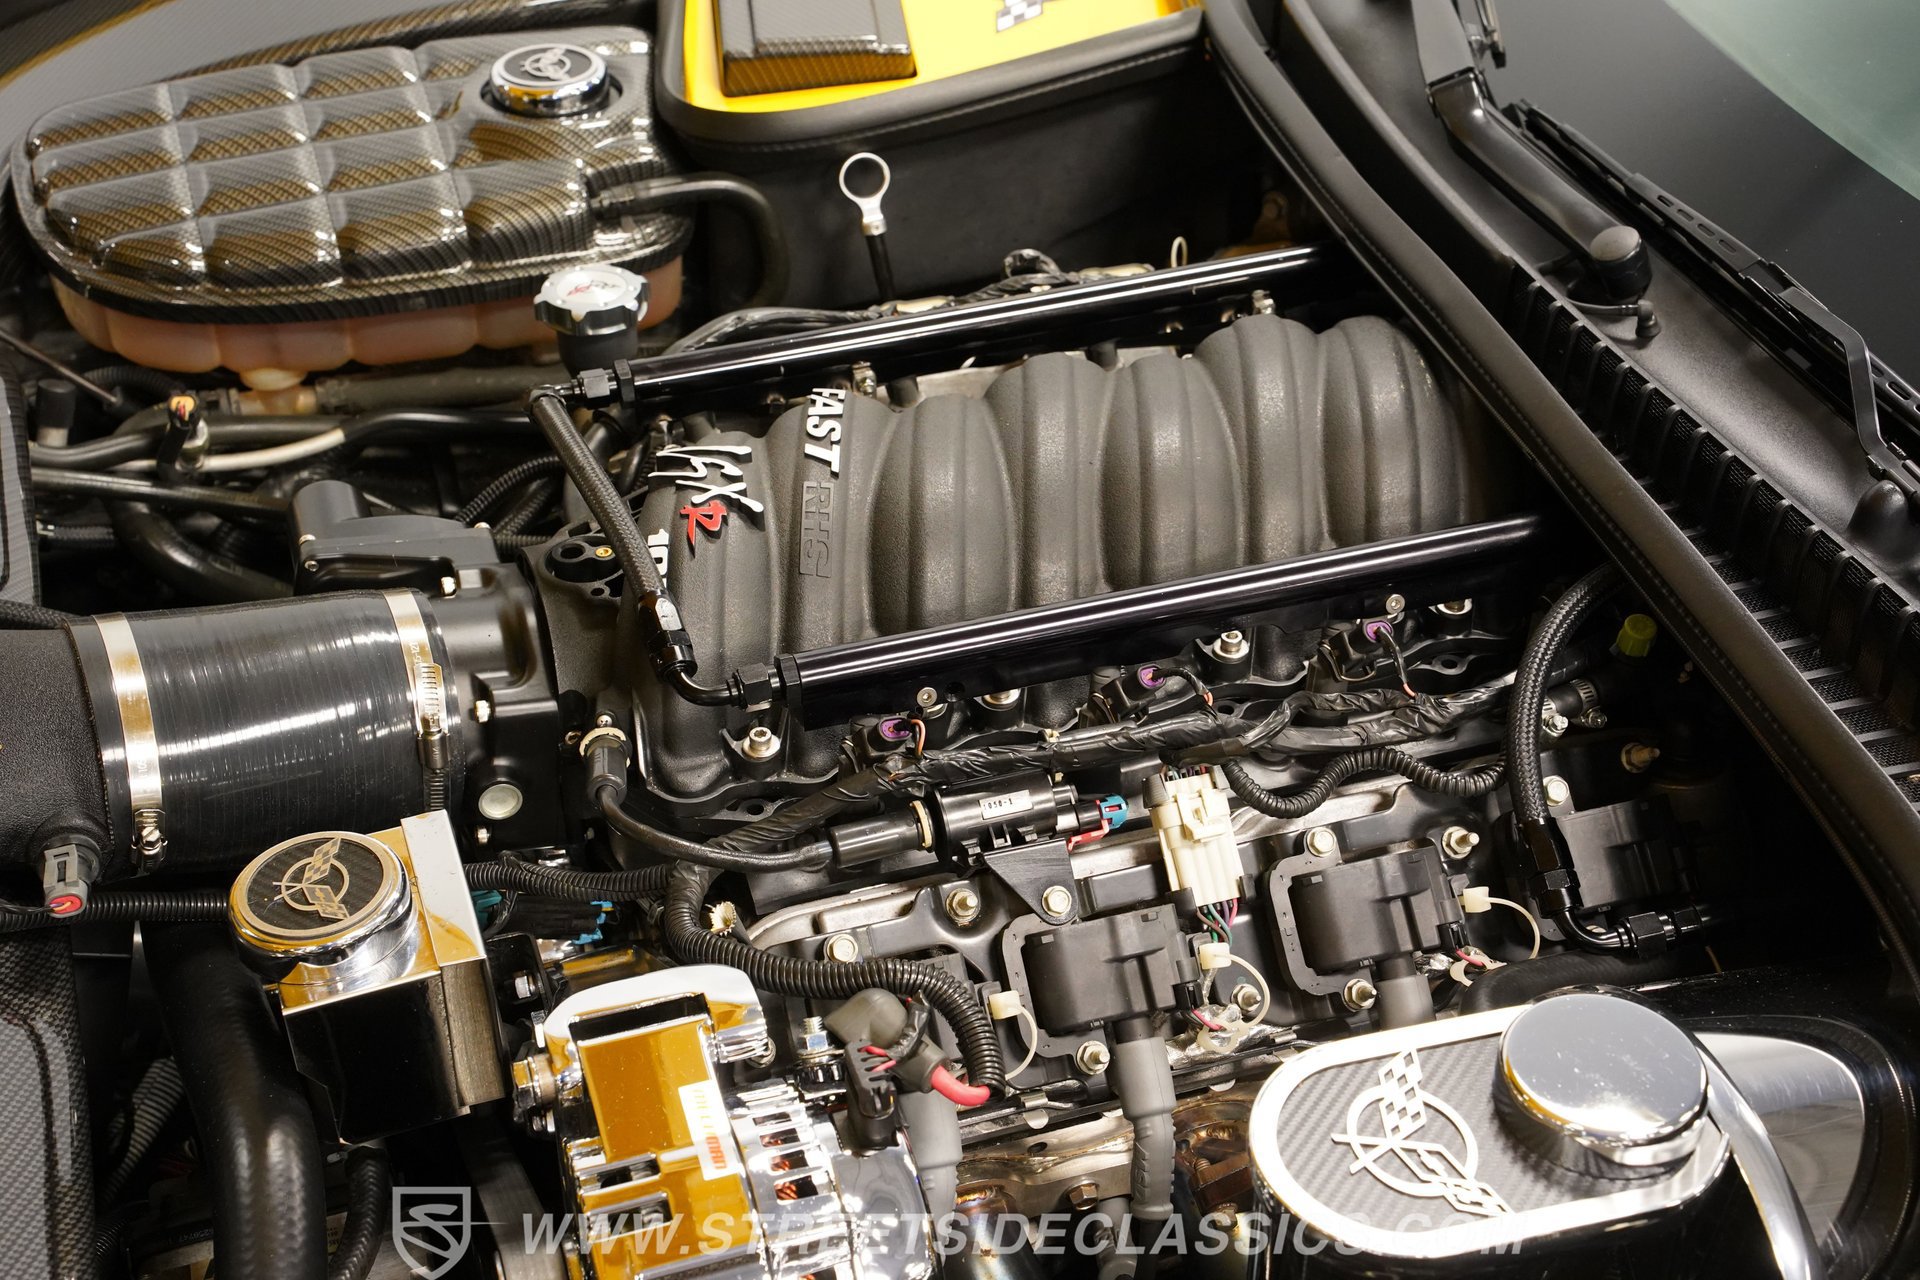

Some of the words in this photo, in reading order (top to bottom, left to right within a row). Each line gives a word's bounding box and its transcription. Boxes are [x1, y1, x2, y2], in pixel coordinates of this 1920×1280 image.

[804, 387, 847, 477] FAST
[647, 528, 670, 589] 10
[801, 483, 834, 578] RHS
